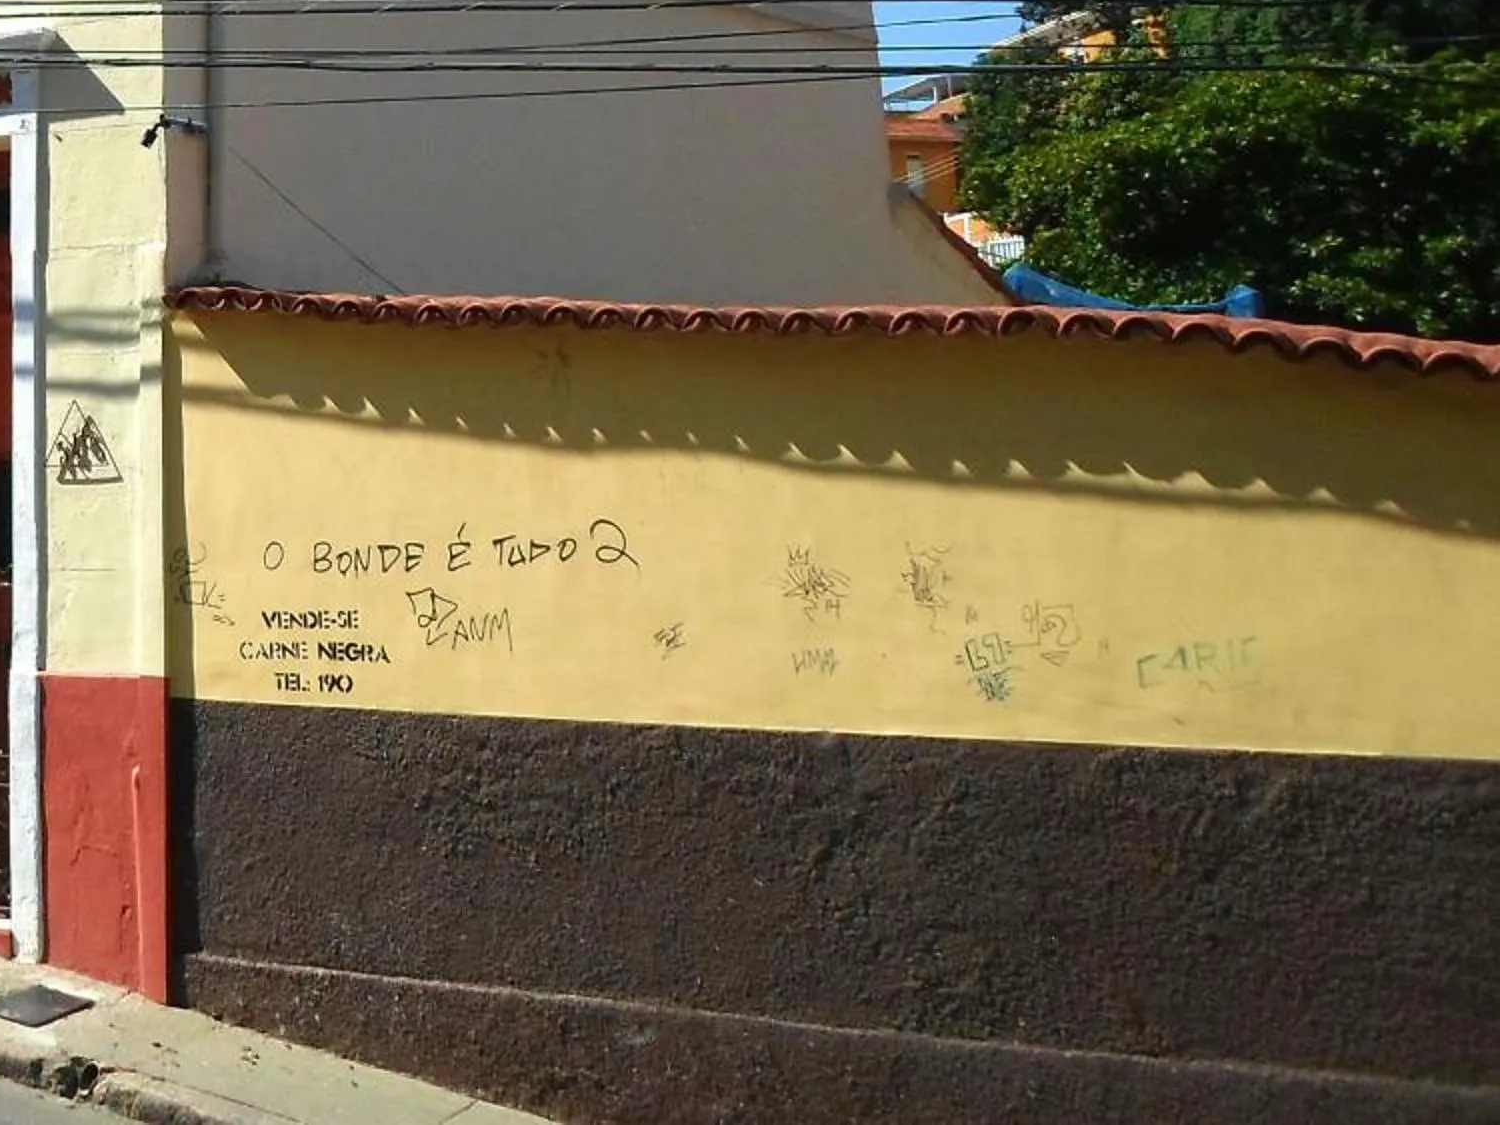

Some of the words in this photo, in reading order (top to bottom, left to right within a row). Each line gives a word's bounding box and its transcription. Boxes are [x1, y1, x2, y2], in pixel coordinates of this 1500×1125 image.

[263, 540, 285, 572] O
[313, 541, 425, 579] BONDE
[447, 522, 472, 572] É
[589, 518, 640, 567] 2
[261, 610, 359, 629] VENDE-SE
[239, 641, 309, 660] CARNE
[317, 642, 391, 663] NEGRA
[318, 672, 353, 694] 190
